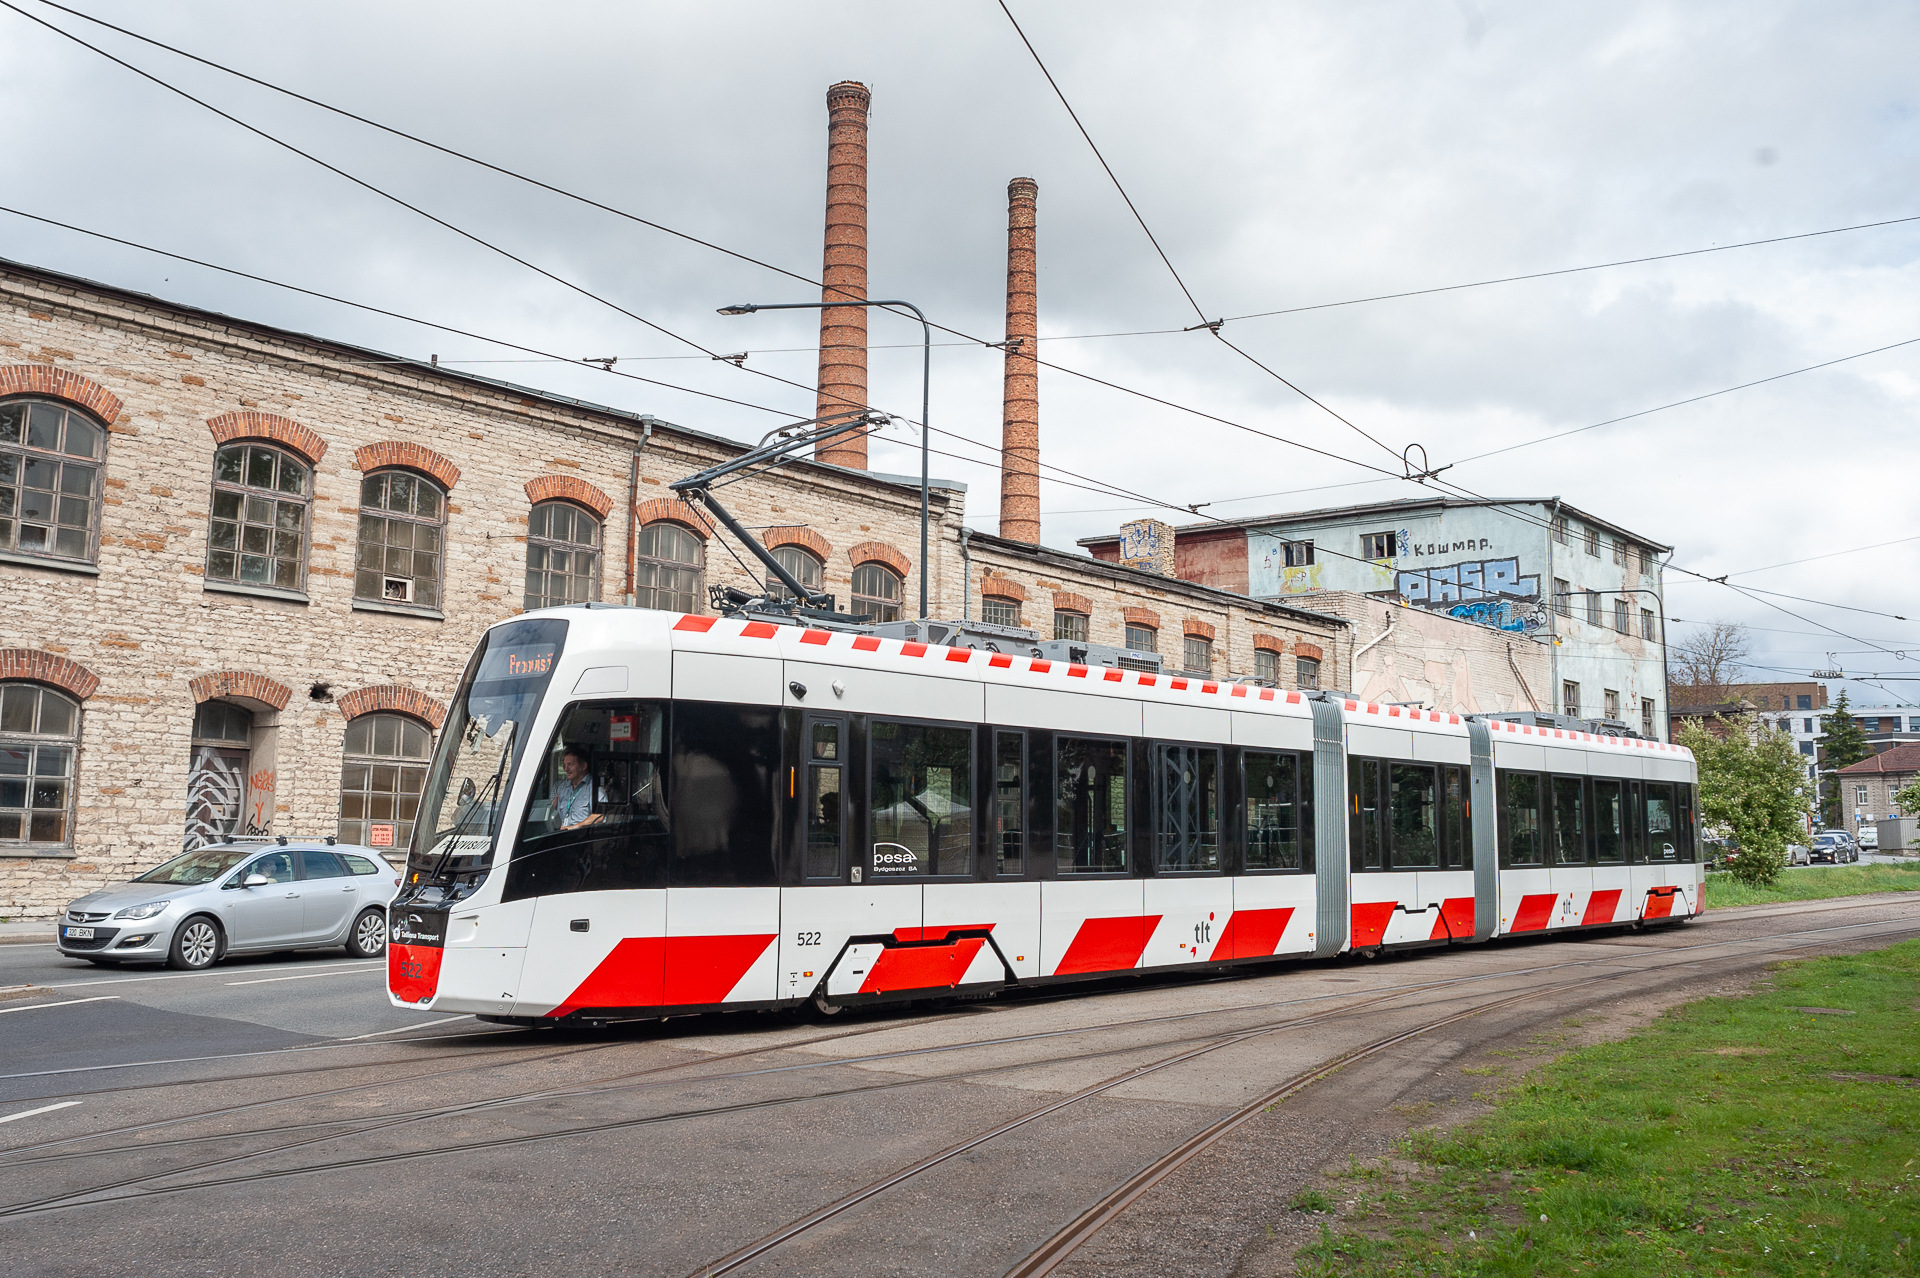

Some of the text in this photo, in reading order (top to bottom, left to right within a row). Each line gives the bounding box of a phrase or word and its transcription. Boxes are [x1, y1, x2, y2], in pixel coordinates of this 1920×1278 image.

[873, 853, 913, 866] pesa
[797, 931, 822, 947] 522
[1194, 920, 1211, 944] tlt
[400, 961, 423, 979] 522
